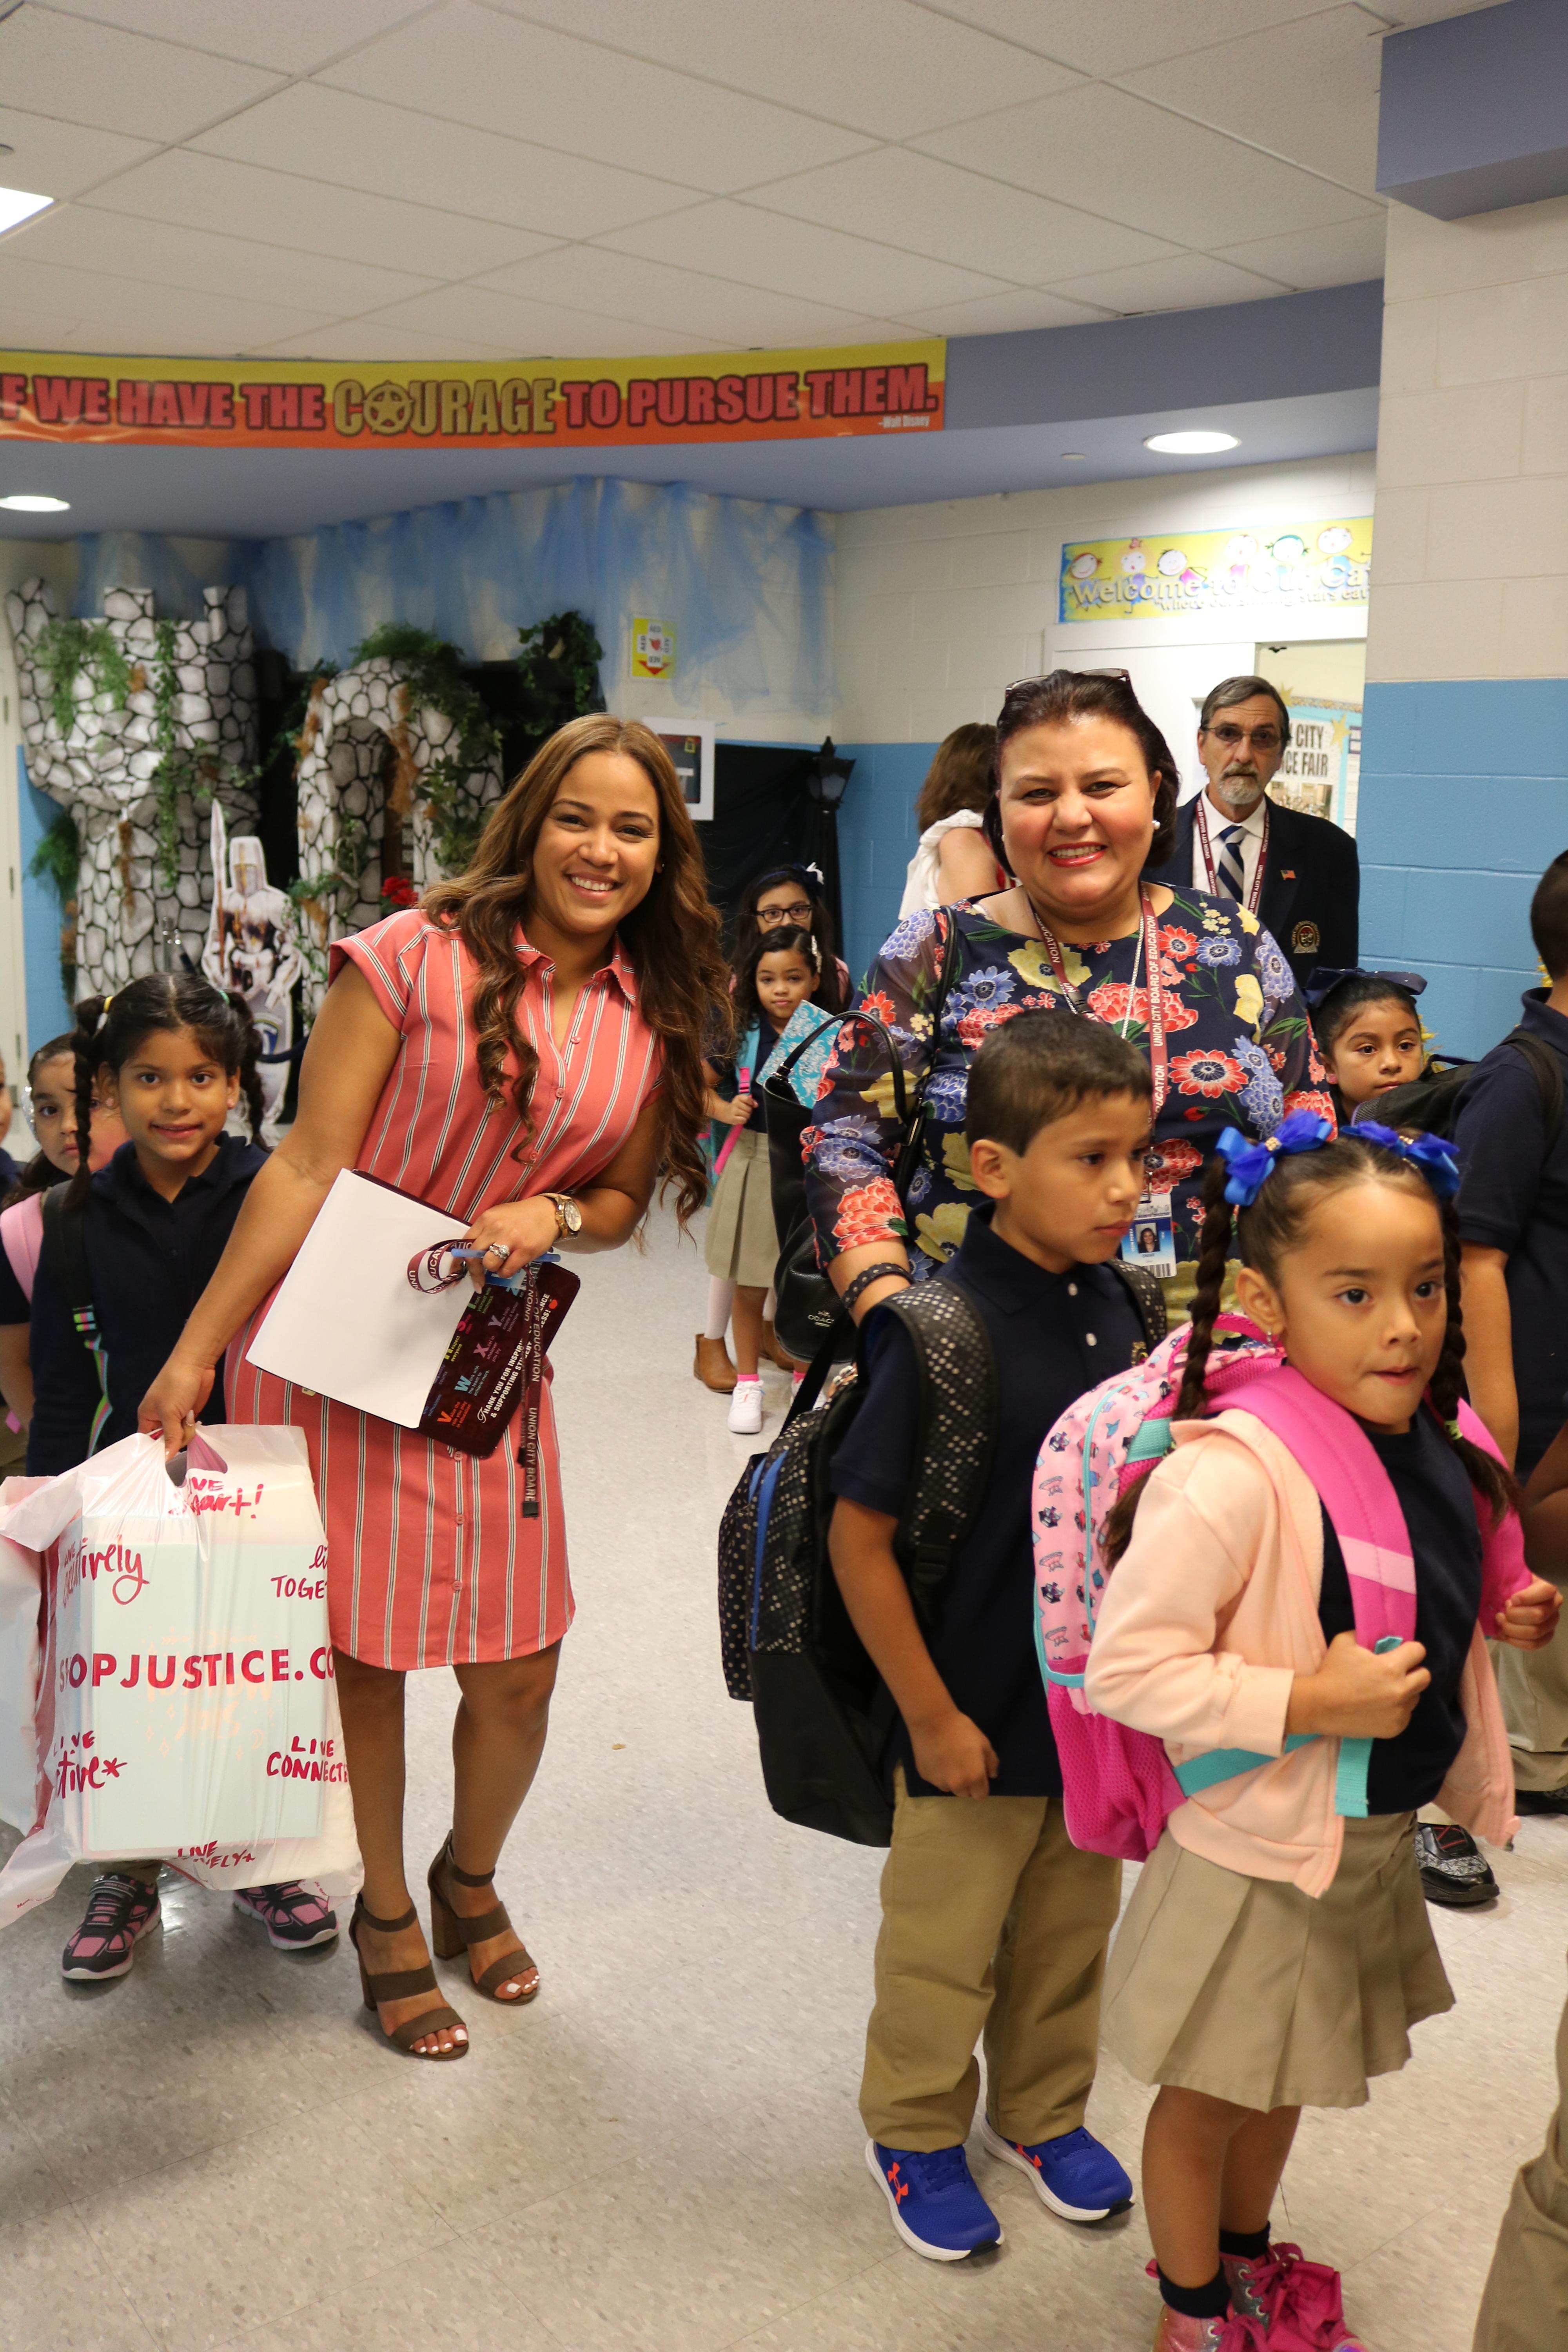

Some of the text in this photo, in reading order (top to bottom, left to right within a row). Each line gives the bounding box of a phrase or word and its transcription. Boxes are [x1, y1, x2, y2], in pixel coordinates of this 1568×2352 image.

[32, 376, 110, 425] WE
[118, 379, 234, 428] HAVE
[240, 383, 325, 430] THE
[334, 379, 556, 435] COURAGE
[561, 379, 621, 429] TO
[627, 371, 799, 427] PURSUE
[805, 363, 938, 419] THEM.
[1073, 578, 1199, 604] Welcome
[1296, 724, 1323, 748] CITY
[1302, 751, 1328, 776] FAIR
[1250, 891, 1258, 908] BOARD
[1146, 915, 1163, 1047] UNION CITY BOARD OF EDUCATION
[476, 1295, 488, 1312] yourself
[481, 1295, 494, 1314] kindness
[502, 1317, 511, 1330] create
[510, 1301, 519, 1314] better
[524, 1290, 534, 1321] UNION
[534, 1307, 540, 1321] OF
[506, 1312, 519, 1332] tomorrow
[450, 1343, 463, 1363] everyone
[486, 1341, 498, 1360] whatever
[532, 1323, 541, 1382] EDUCATION
[473, 1380, 484, 1396] achieve
[477, 1396, 497, 1423] THANK
[493, 1381, 504, 1394] YOU
[501, 1367, 511, 1381] FOR
[494, 1370, 519, 1412] SUPPORTING
[427, 1393, 442, 1417] enthusiasm
[527, 1407, 538, 1440] UNION
[526, 1443, 537, 1466] CITY
[271, 1575, 327, 1600] TOGE
[291, 1736, 334, 1757] LIVE
